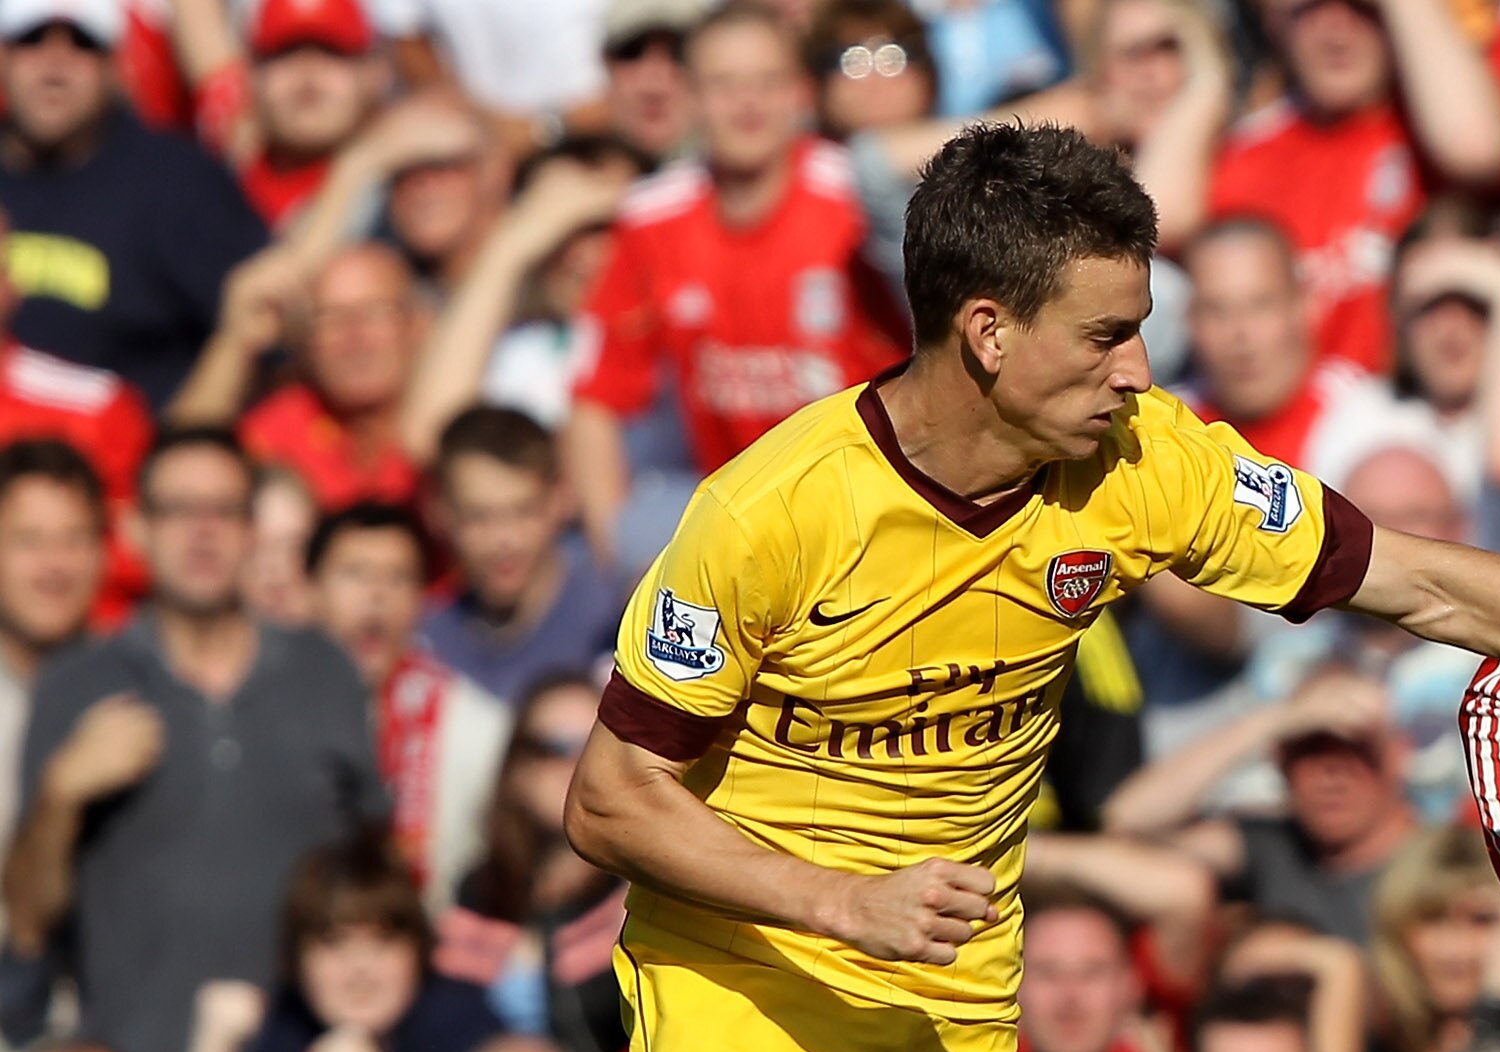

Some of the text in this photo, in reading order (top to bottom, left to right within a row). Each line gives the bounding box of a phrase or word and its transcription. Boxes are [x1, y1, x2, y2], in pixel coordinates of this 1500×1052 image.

[1056, 560, 1104, 576] Arsenal
[651, 639, 698, 661] BARCLAYS
[905, 658, 1007, 696] Fly
